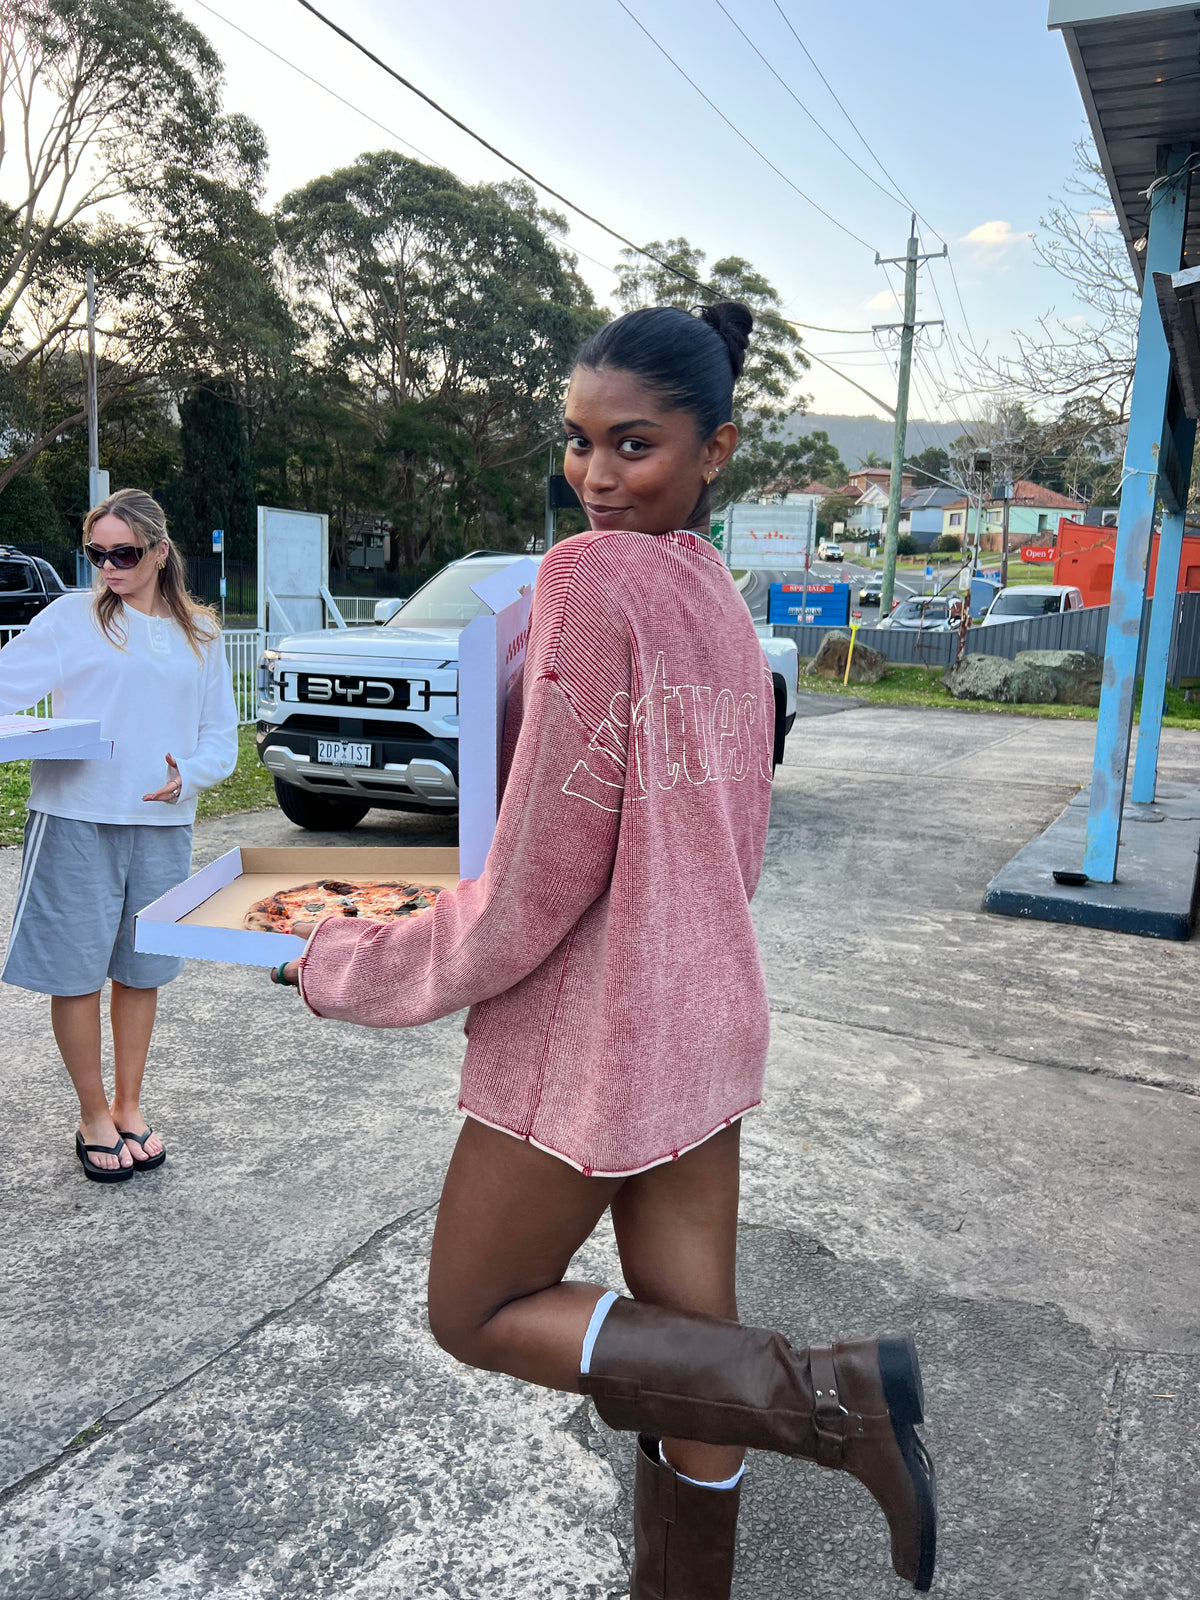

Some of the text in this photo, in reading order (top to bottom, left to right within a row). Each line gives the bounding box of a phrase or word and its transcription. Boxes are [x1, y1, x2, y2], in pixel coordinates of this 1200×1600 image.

[1025, 549, 1055, 559] Open 7
[308, 677, 395, 704] BYD
